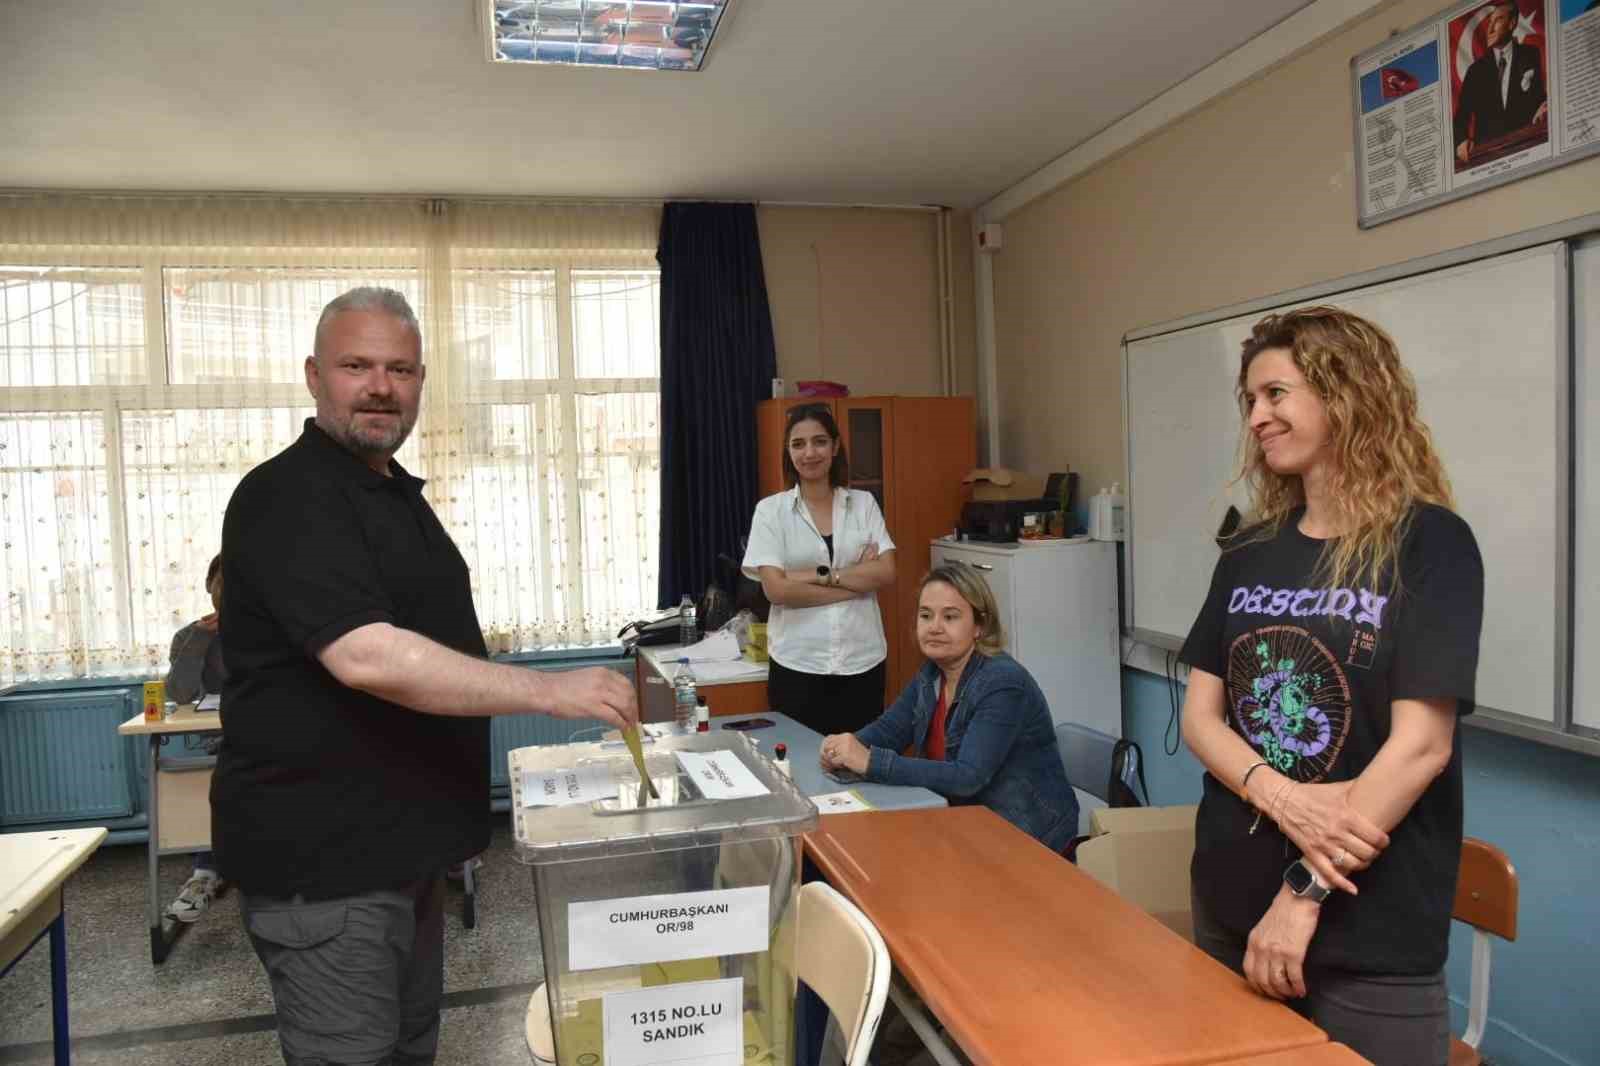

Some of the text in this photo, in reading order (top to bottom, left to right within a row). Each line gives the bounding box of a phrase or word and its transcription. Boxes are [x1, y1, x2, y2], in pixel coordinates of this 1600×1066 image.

[609, 903, 729, 924] CUMHURBAŞKANI
[656, 920, 695, 934] OR/98
[630, 1002, 722, 1025] 1315 NO.LU
[642, 1022, 705, 1043] SANDIK
